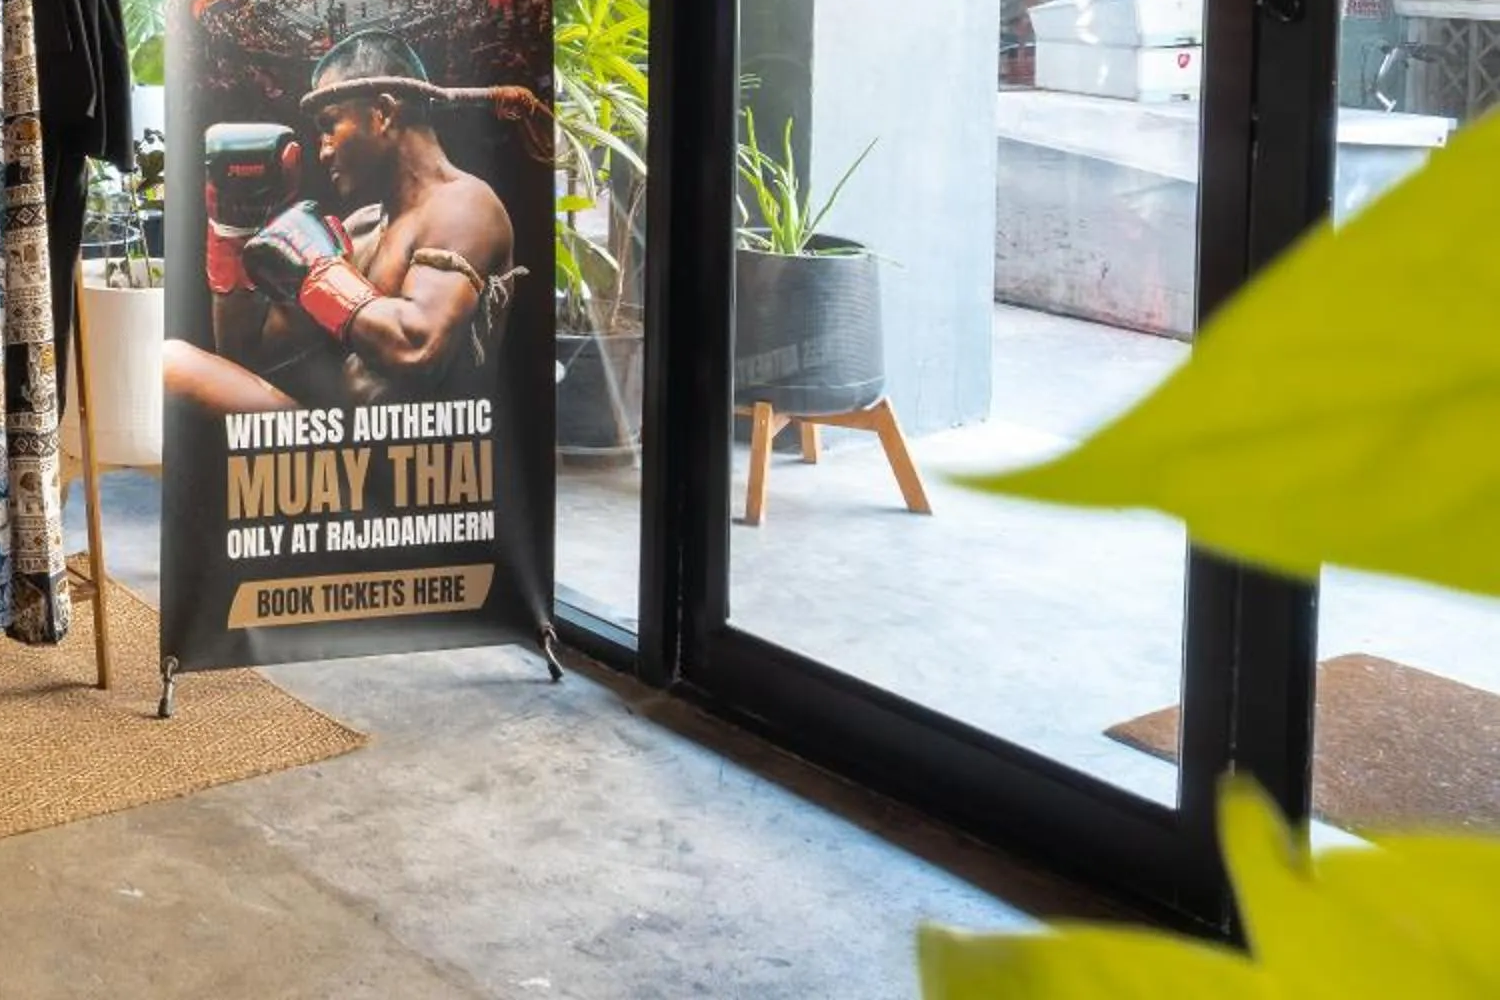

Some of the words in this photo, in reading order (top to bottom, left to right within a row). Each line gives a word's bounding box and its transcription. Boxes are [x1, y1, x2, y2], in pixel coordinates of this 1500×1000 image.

[226, 409, 345, 450] WITNESS
[353, 399, 493, 443] AUTHENTIC
[227, 447, 371, 521] MUAY
[388, 440, 494, 508] THAI
[227, 521, 284, 560] ONLY
[291, 522, 320, 553] AT
[326, 510, 495, 552] RAJADAMNERN
[256, 585, 316, 619] BOOK
[321, 579, 406, 612] TICKETS
[413, 574, 466, 606] HERE
